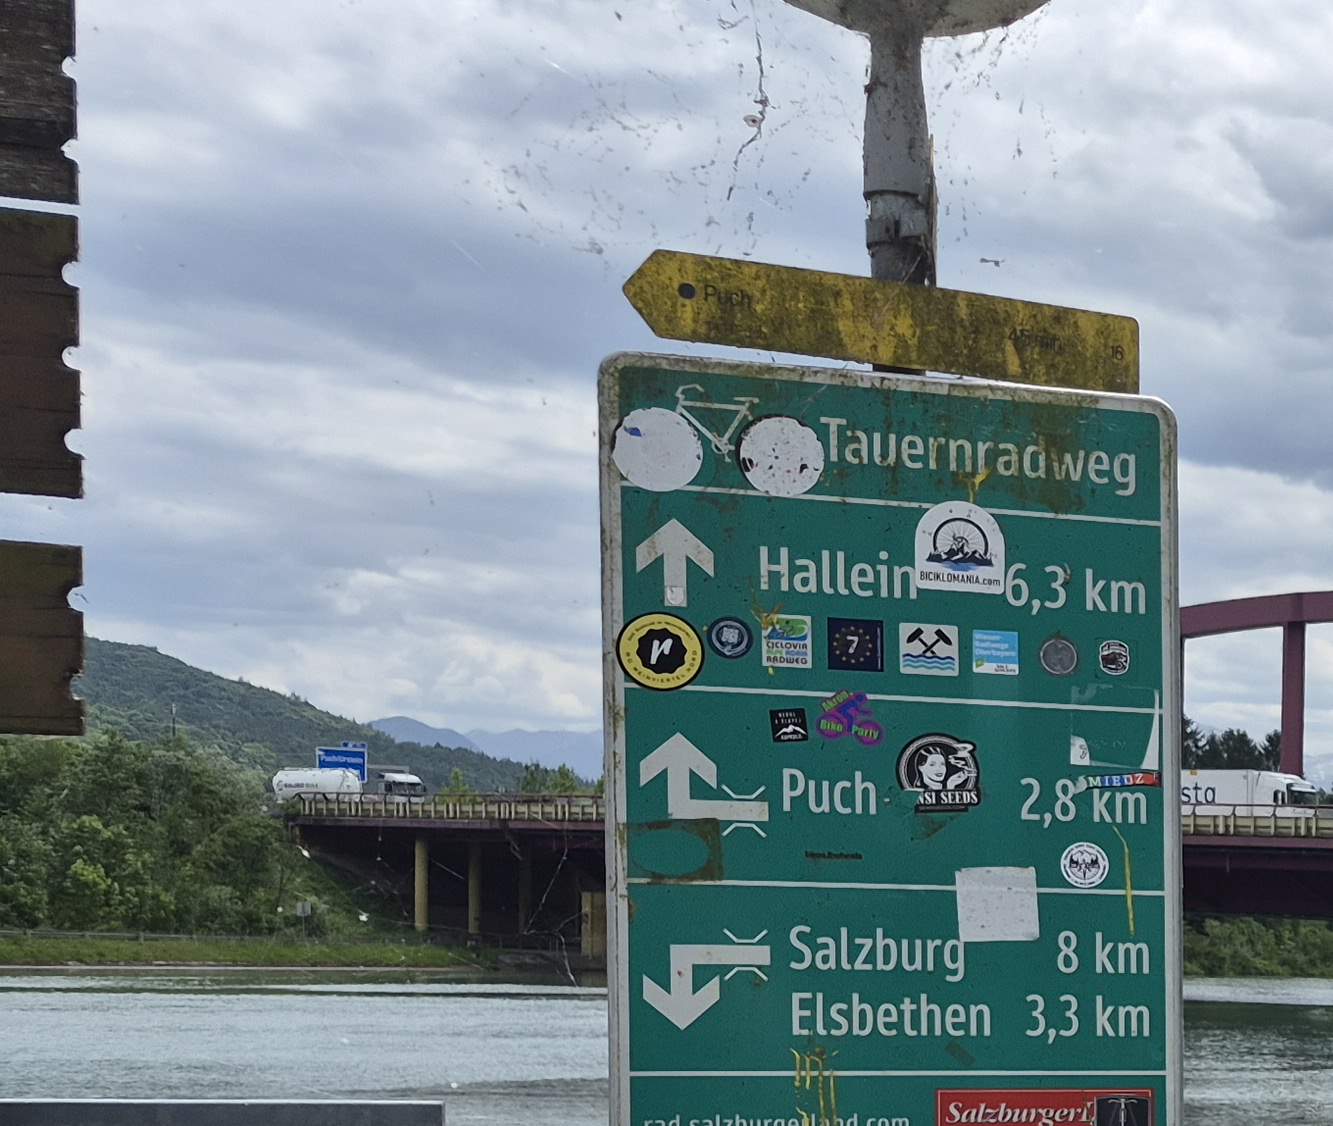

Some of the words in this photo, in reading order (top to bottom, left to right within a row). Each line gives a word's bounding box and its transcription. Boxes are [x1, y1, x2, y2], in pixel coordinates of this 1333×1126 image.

[703, 284, 752, 308] Puch
[1110, 345, 1125, 361] 16
[820, 416, 1137, 496] Tauernradweg
[759, 545, 918, 600] Hallein
[1004, 563, 1069, 615] 6,3
[1085, 568, 1147, 614] km
[920, 570, 1001, 587] BICIKLOMANIA.com
[846, 635, 859, 654] 7
[766, 655, 808, 665] RADWEG
[821, 689, 851, 712] Akron
[820, 719, 843, 733] Bike
[852, 724, 880, 740] Party
[782, 768, 878, 815] Puch
[1020, 778, 1077, 828] 2,8
[1092, 788, 1148, 824] km
[940, 790, 978, 805] SEEDS
[789, 924, 966, 982] Salzburg
[1056, 932, 1079, 971] 8
[1094, 932, 1150, 974] km
[791, 991, 992, 1037] Elsbethen
[1025, 995, 1079, 1044] 3,3
[1095, 996, 1151, 1038] km
